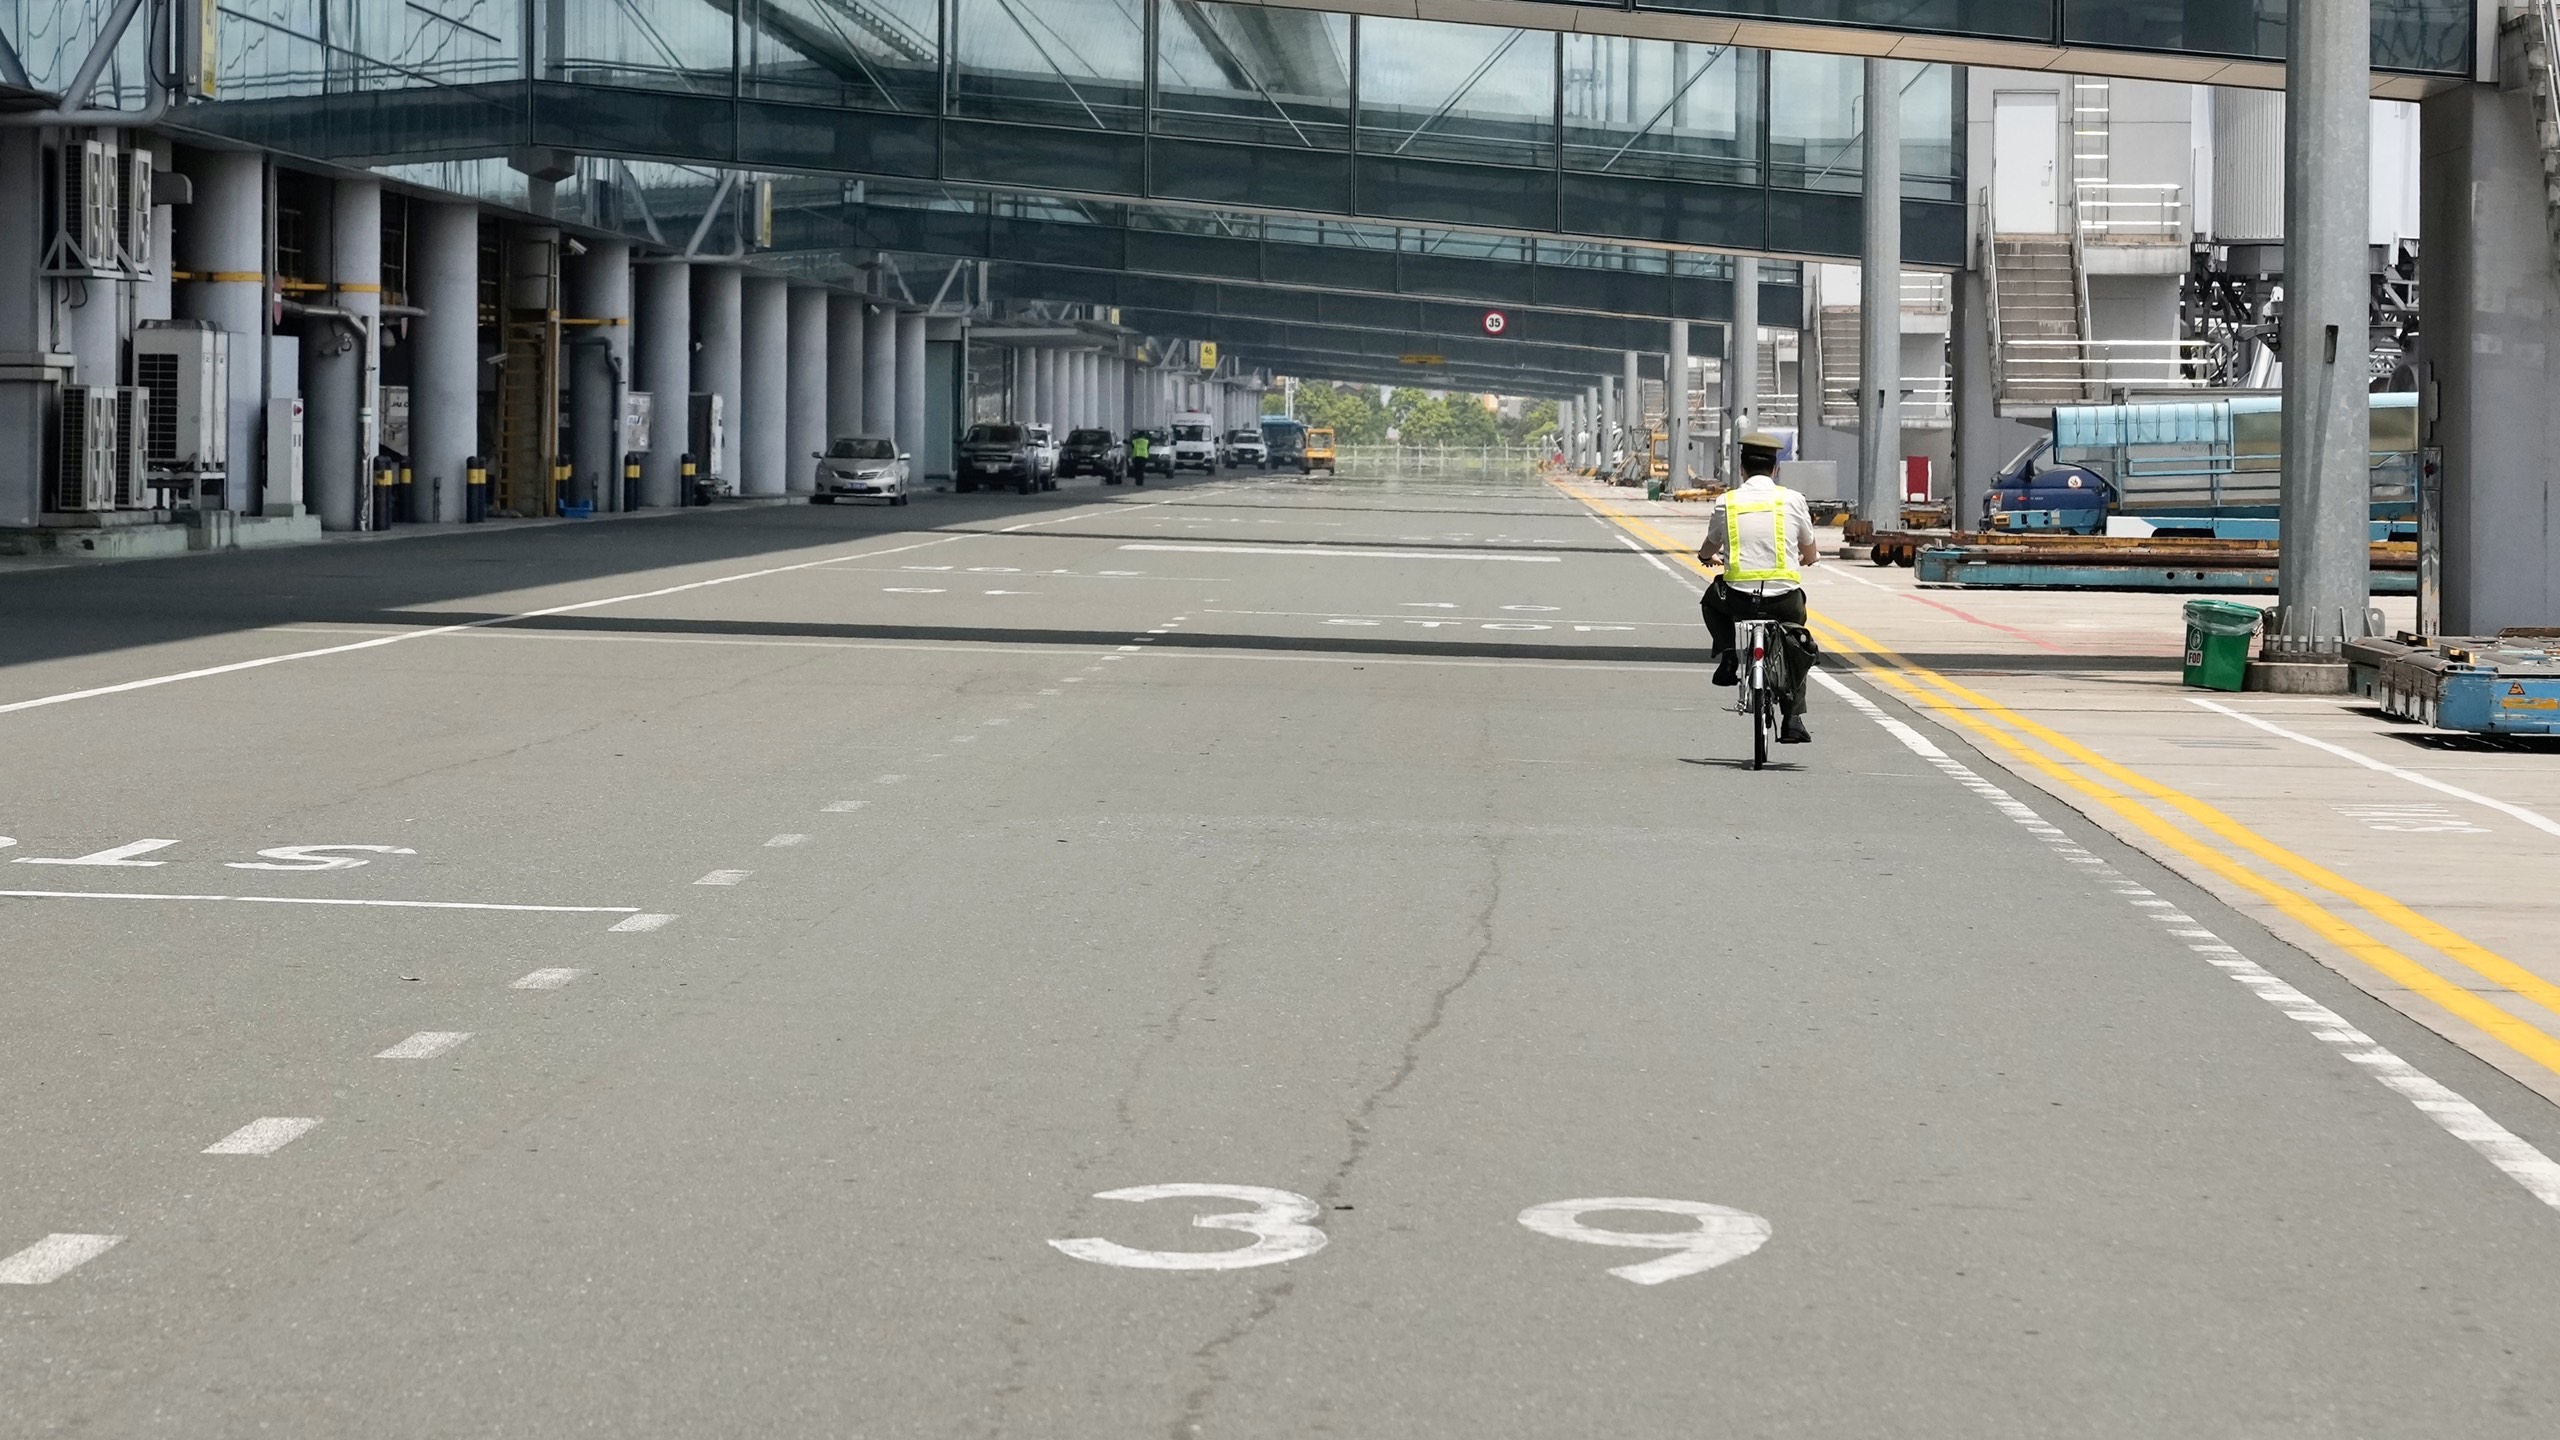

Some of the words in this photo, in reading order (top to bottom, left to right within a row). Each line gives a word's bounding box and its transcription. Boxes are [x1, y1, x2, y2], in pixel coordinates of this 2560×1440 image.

[1489, 317, 1501, 328] 35
[1317, 618, 1636, 632] STOP
[2188, 652, 2202, 664] FOD
[0, 835, 417, 871] ST
[1047, 1182, 1774, 1286] 39
